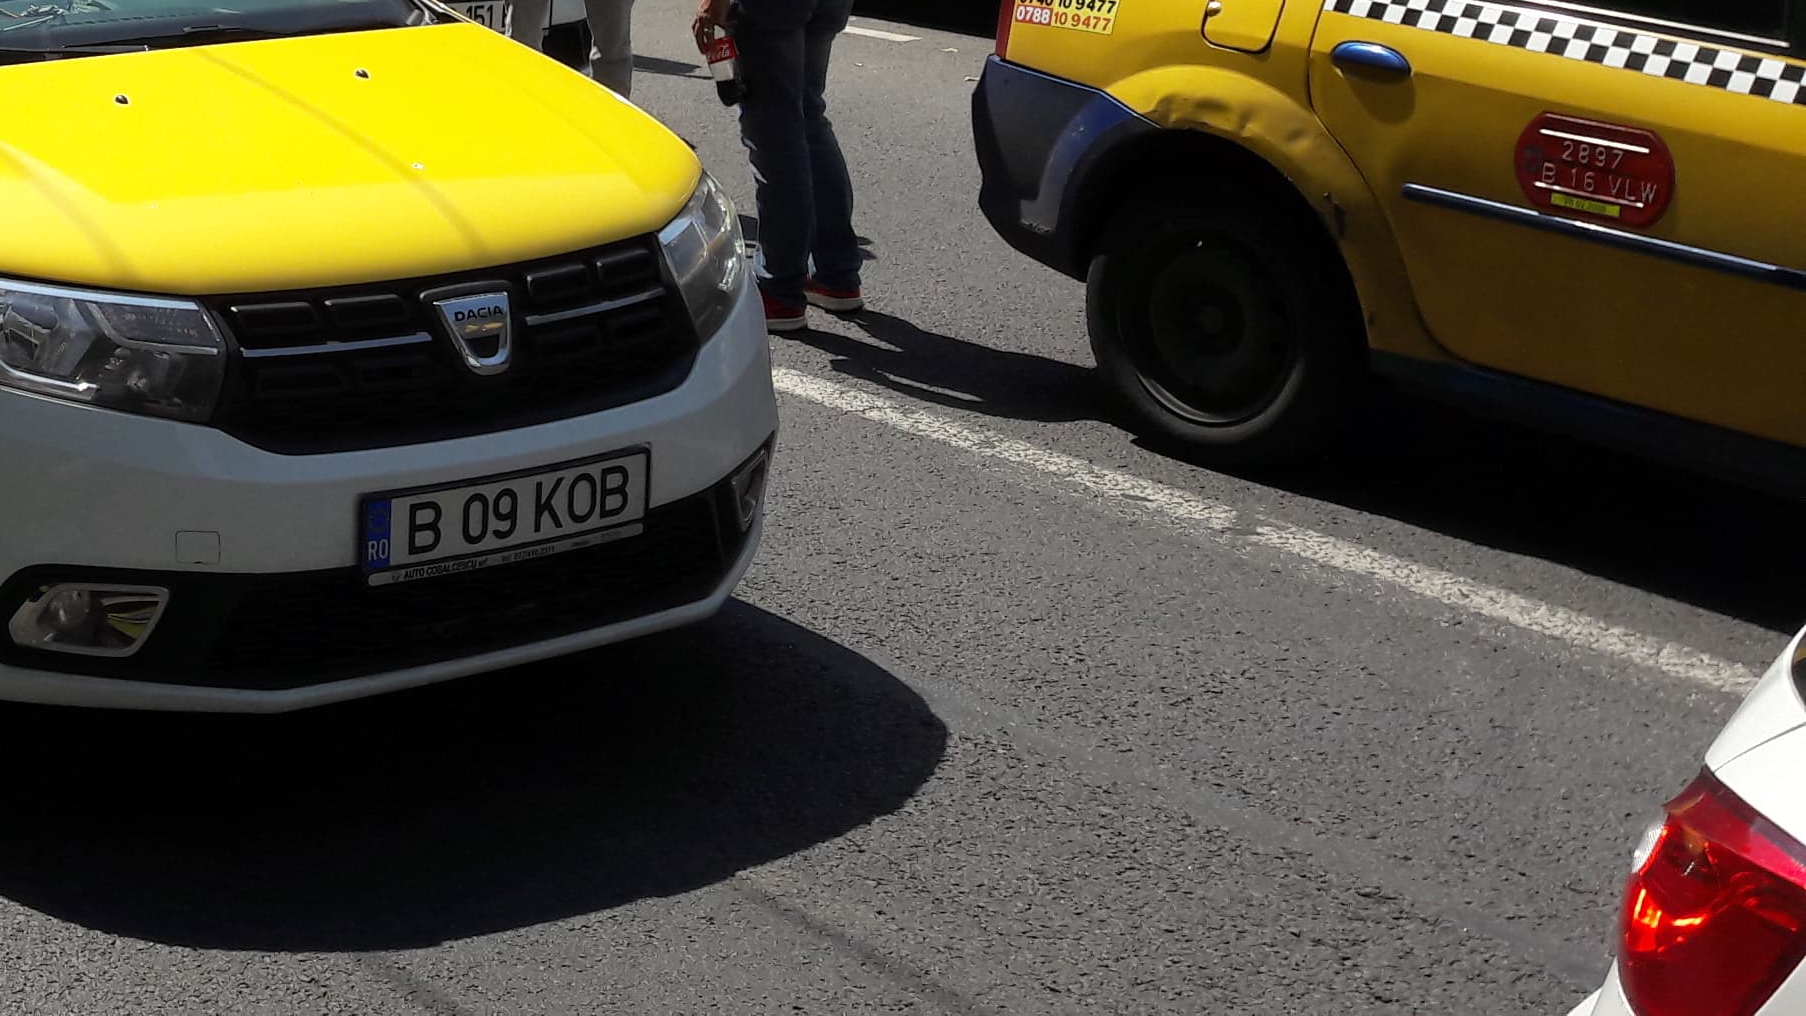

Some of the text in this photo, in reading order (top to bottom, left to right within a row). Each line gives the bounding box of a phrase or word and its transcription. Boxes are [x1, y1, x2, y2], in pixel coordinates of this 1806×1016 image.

[1016, 5, 1112, 32] 0788 10 9477
[1561, 140, 1625, 170] 2897
[1541, 161, 1556, 184] B
[1570, 168, 1595, 192] 16
[1609, 174, 1658, 205] VLW
[454, 305, 503, 322] DACIA
[367, 464, 630, 561] RO B 09 KOB
[403, 567, 425, 579] AUTO
